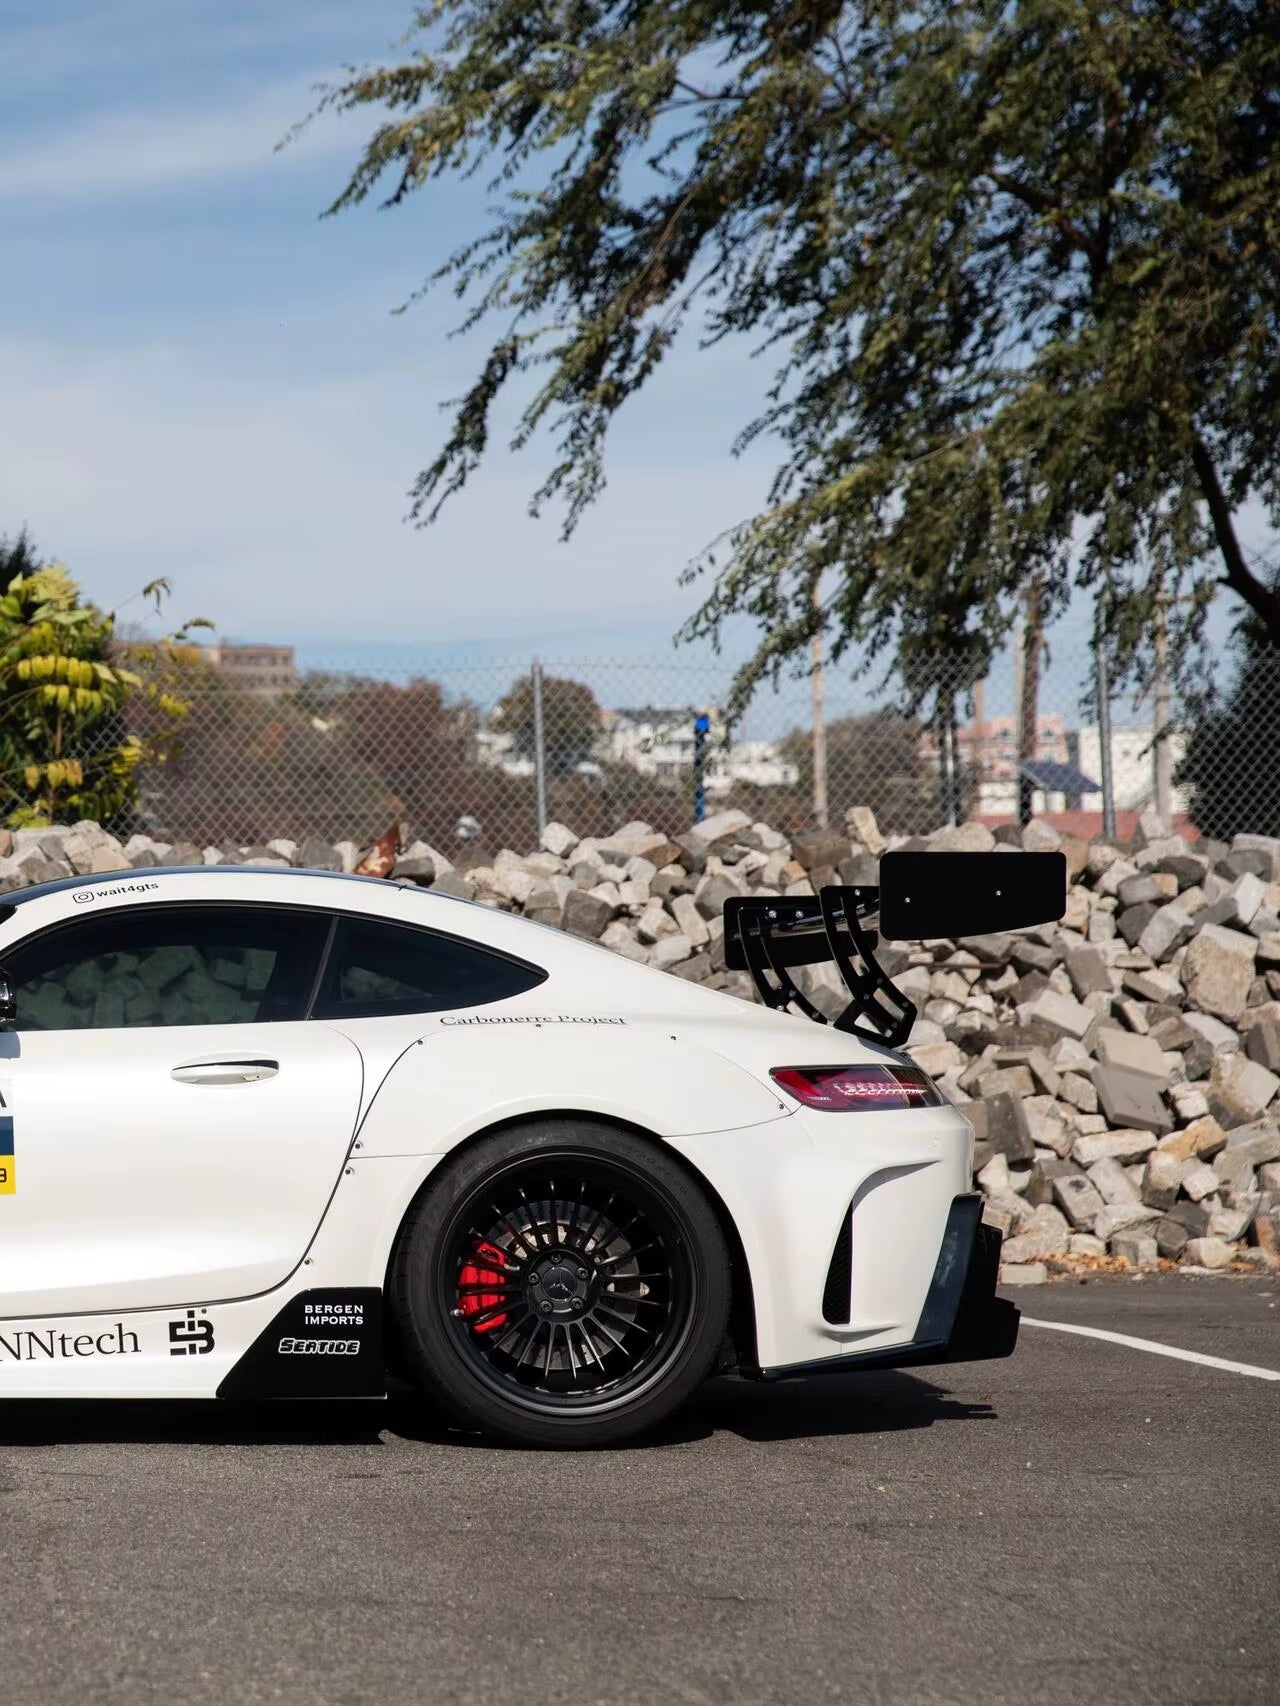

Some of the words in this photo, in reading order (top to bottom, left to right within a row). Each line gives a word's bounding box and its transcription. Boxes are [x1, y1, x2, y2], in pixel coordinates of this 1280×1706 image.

[96, 883, 159, 897] wait4gts
[558, 1014, 628, 1026] Project
[304, 1304, 364, 1314] BERGEN
[304, 1315, 364, 1325] IMPORTS
[278, 1337, 360, 1355] SEATIDE
